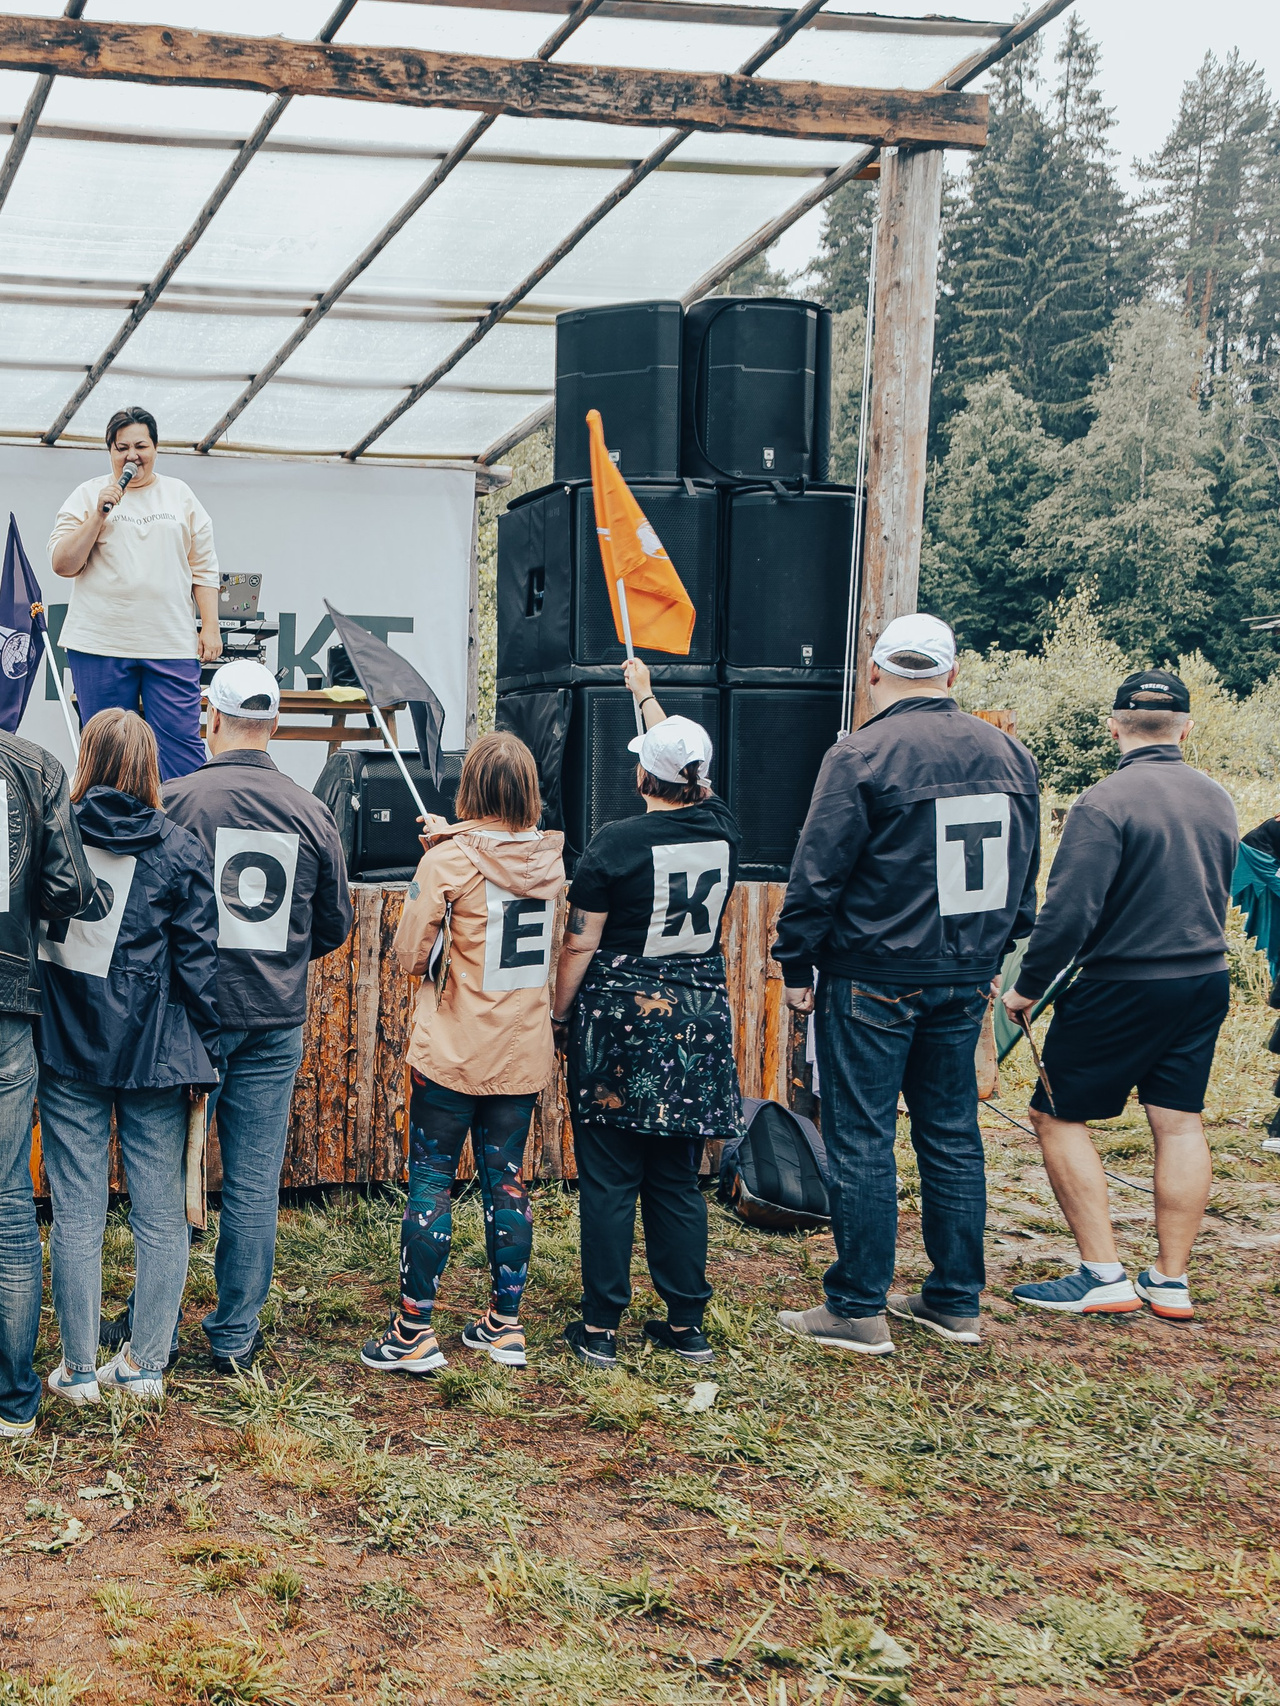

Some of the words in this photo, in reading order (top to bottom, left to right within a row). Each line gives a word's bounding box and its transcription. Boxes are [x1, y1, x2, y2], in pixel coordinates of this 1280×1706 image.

[220, 851, 288, 923] О
[945, 820, 1002, 892] Т
[498, 899, 547, 970] Е
[660, 868, 722, 938] К
